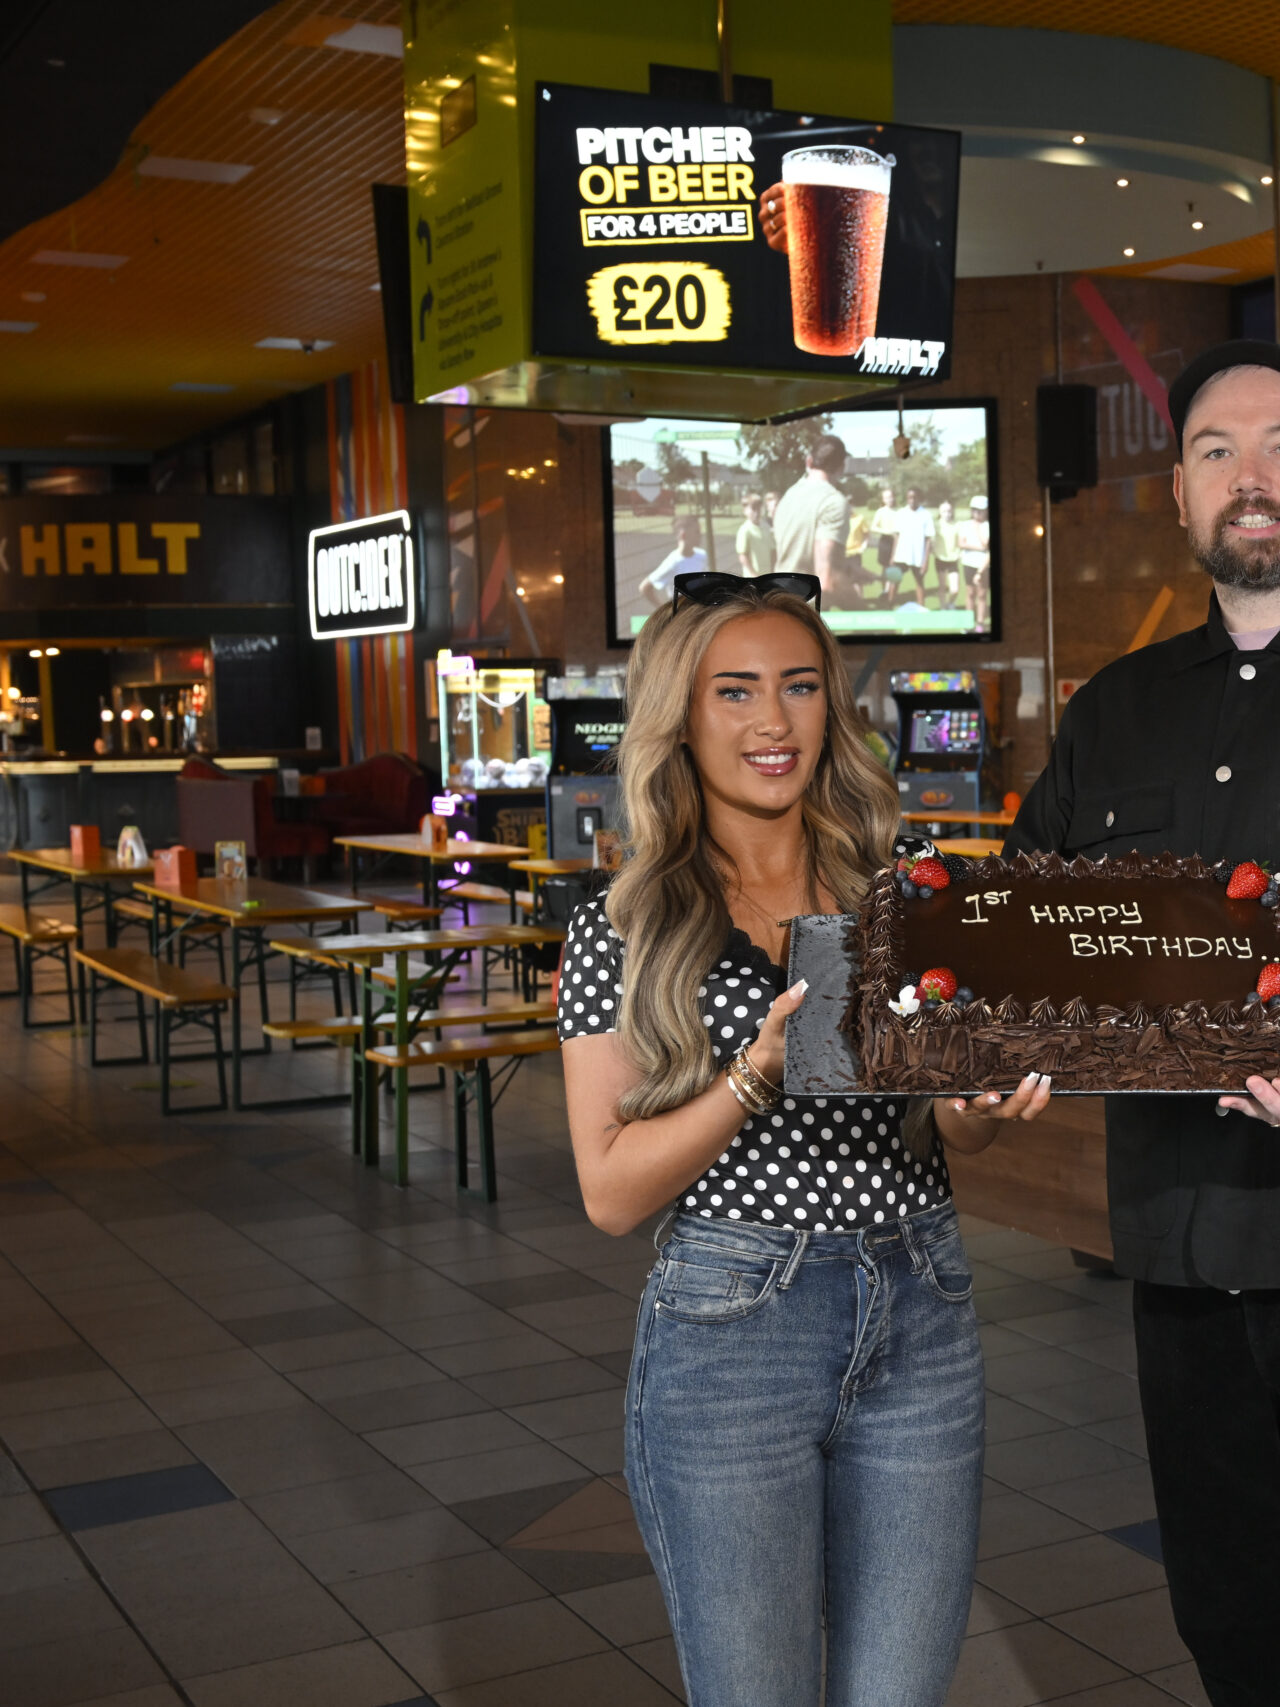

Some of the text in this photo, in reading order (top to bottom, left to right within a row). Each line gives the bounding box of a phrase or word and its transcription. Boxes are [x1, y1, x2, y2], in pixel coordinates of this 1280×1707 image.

[576, 126, 756, 165] PITCHER
[578, 163, 757, 205] OF BEER
[586, 211, 747, 239] FOR 4 PEOPLE
[612, 274, 707, 332] £20
[853, 336, 946, 376] HALT
[20, 522, 201, 576] HALT
[1030, 901, 1143, 925] HAPPY
